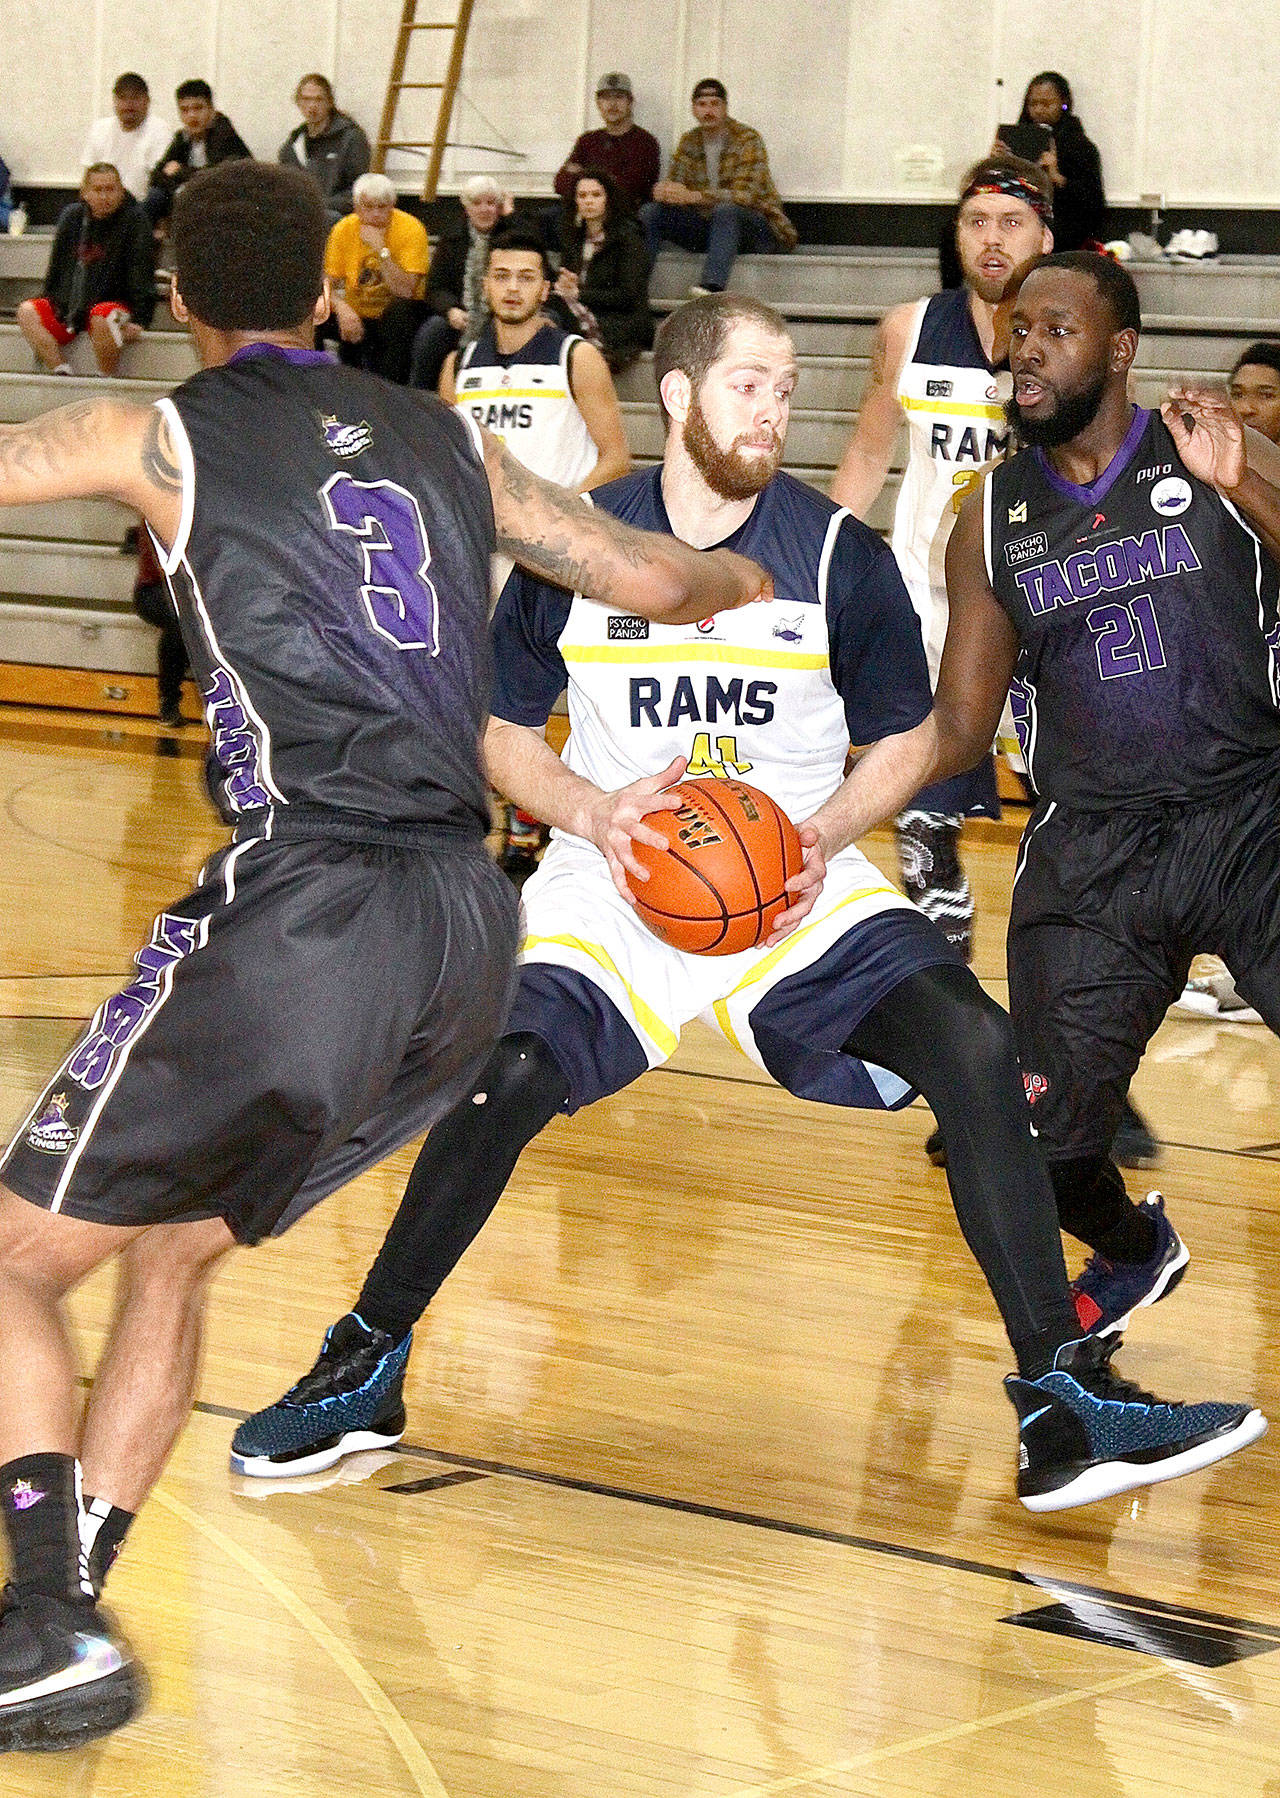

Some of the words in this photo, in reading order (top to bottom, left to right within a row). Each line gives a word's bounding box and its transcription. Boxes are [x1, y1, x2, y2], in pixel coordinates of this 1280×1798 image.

[471, 404, 533, 429] RAMS
[931, 423, 1008, 462] RAM
[1009, 535, 1043, 553] PSYCHO
[1010, 545, 1044, 562] PANDA
[320, 470, 440, 658] 3
[1014, 523, 1202, 617] TACOMA
[609, 618, 646, 628] PSYCHO
[609, 628, 646, 639] PANDA
[1086, 593, 1167, 680] 21
[629, 676, 777, 727] RAMS
[28, 1134, 68, 1150] KINGS
